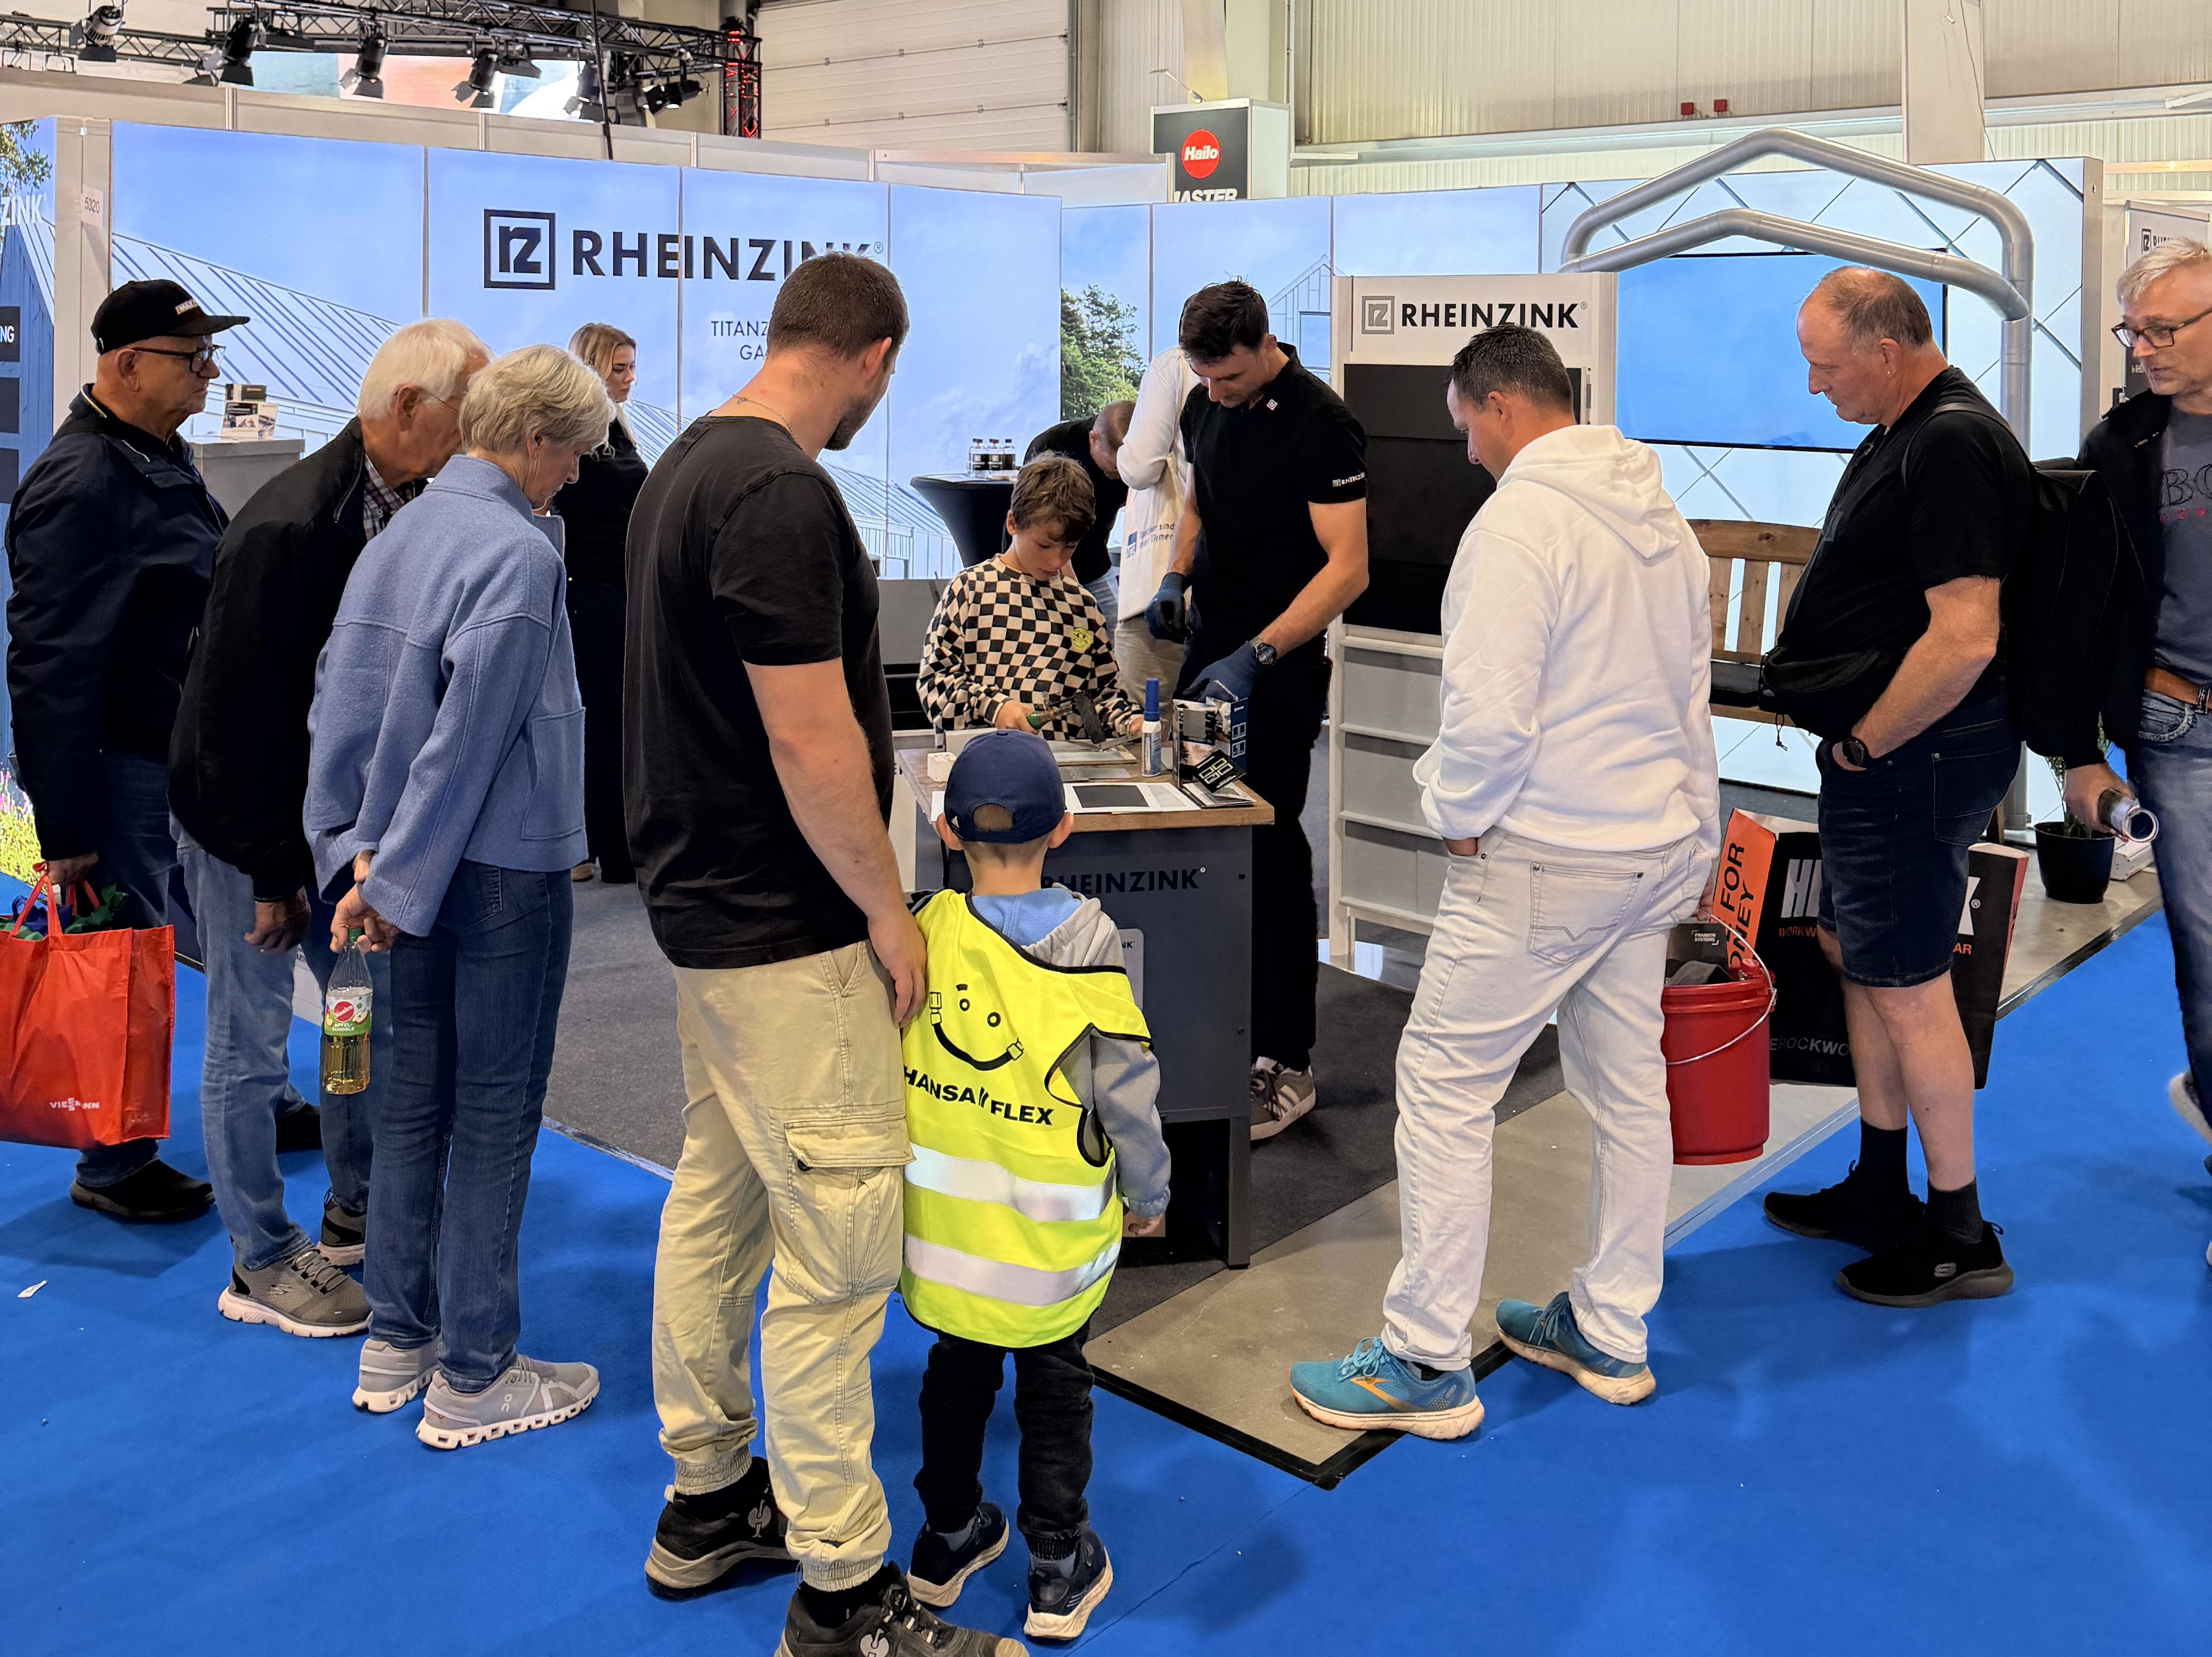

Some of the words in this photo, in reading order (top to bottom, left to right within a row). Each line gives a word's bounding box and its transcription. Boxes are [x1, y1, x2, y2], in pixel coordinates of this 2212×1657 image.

[1184, 145, 1219, 161] Hailo
[85, 197, 100, 214] 5320
[710, 321, 768, 337] TITANZ
[739, 344, 764, 360] GA
[1720, 842, 1745, 912] FOR
[1730, 880, 1754, 967] ONEY
[1779, 926, 1817, 937] WORKW
[904, 1065, 976, 1105] HANSA
[990, 1099, 1054, 1126] FLEX
